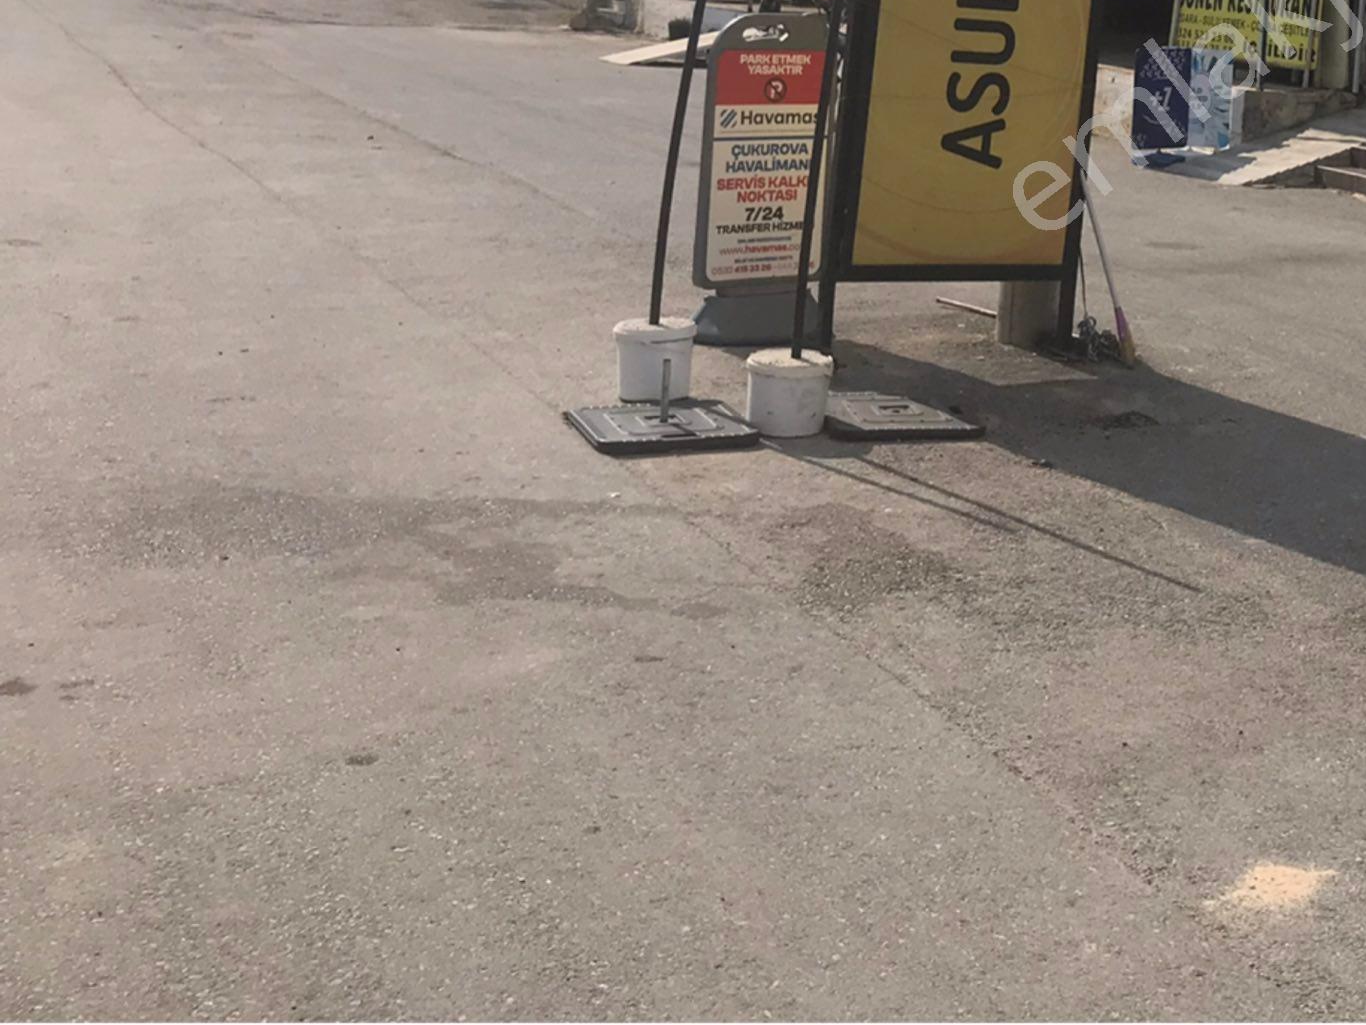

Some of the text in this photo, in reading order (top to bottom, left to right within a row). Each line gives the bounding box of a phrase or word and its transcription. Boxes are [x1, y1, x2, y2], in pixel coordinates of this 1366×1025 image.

[740, 53, 812, 65] PARK ETMEK
[748, 64, 803, 75] YASAKTIR
[731, 143, 808, 160] ÇUKUROVA
[717, 174, 808, 191] SERVİS KALK
[737, 189, 798, 203] NOKTASI
[745, 206, 784, 222] 7/24
[716, 223, 771, 235] TRANSFER
